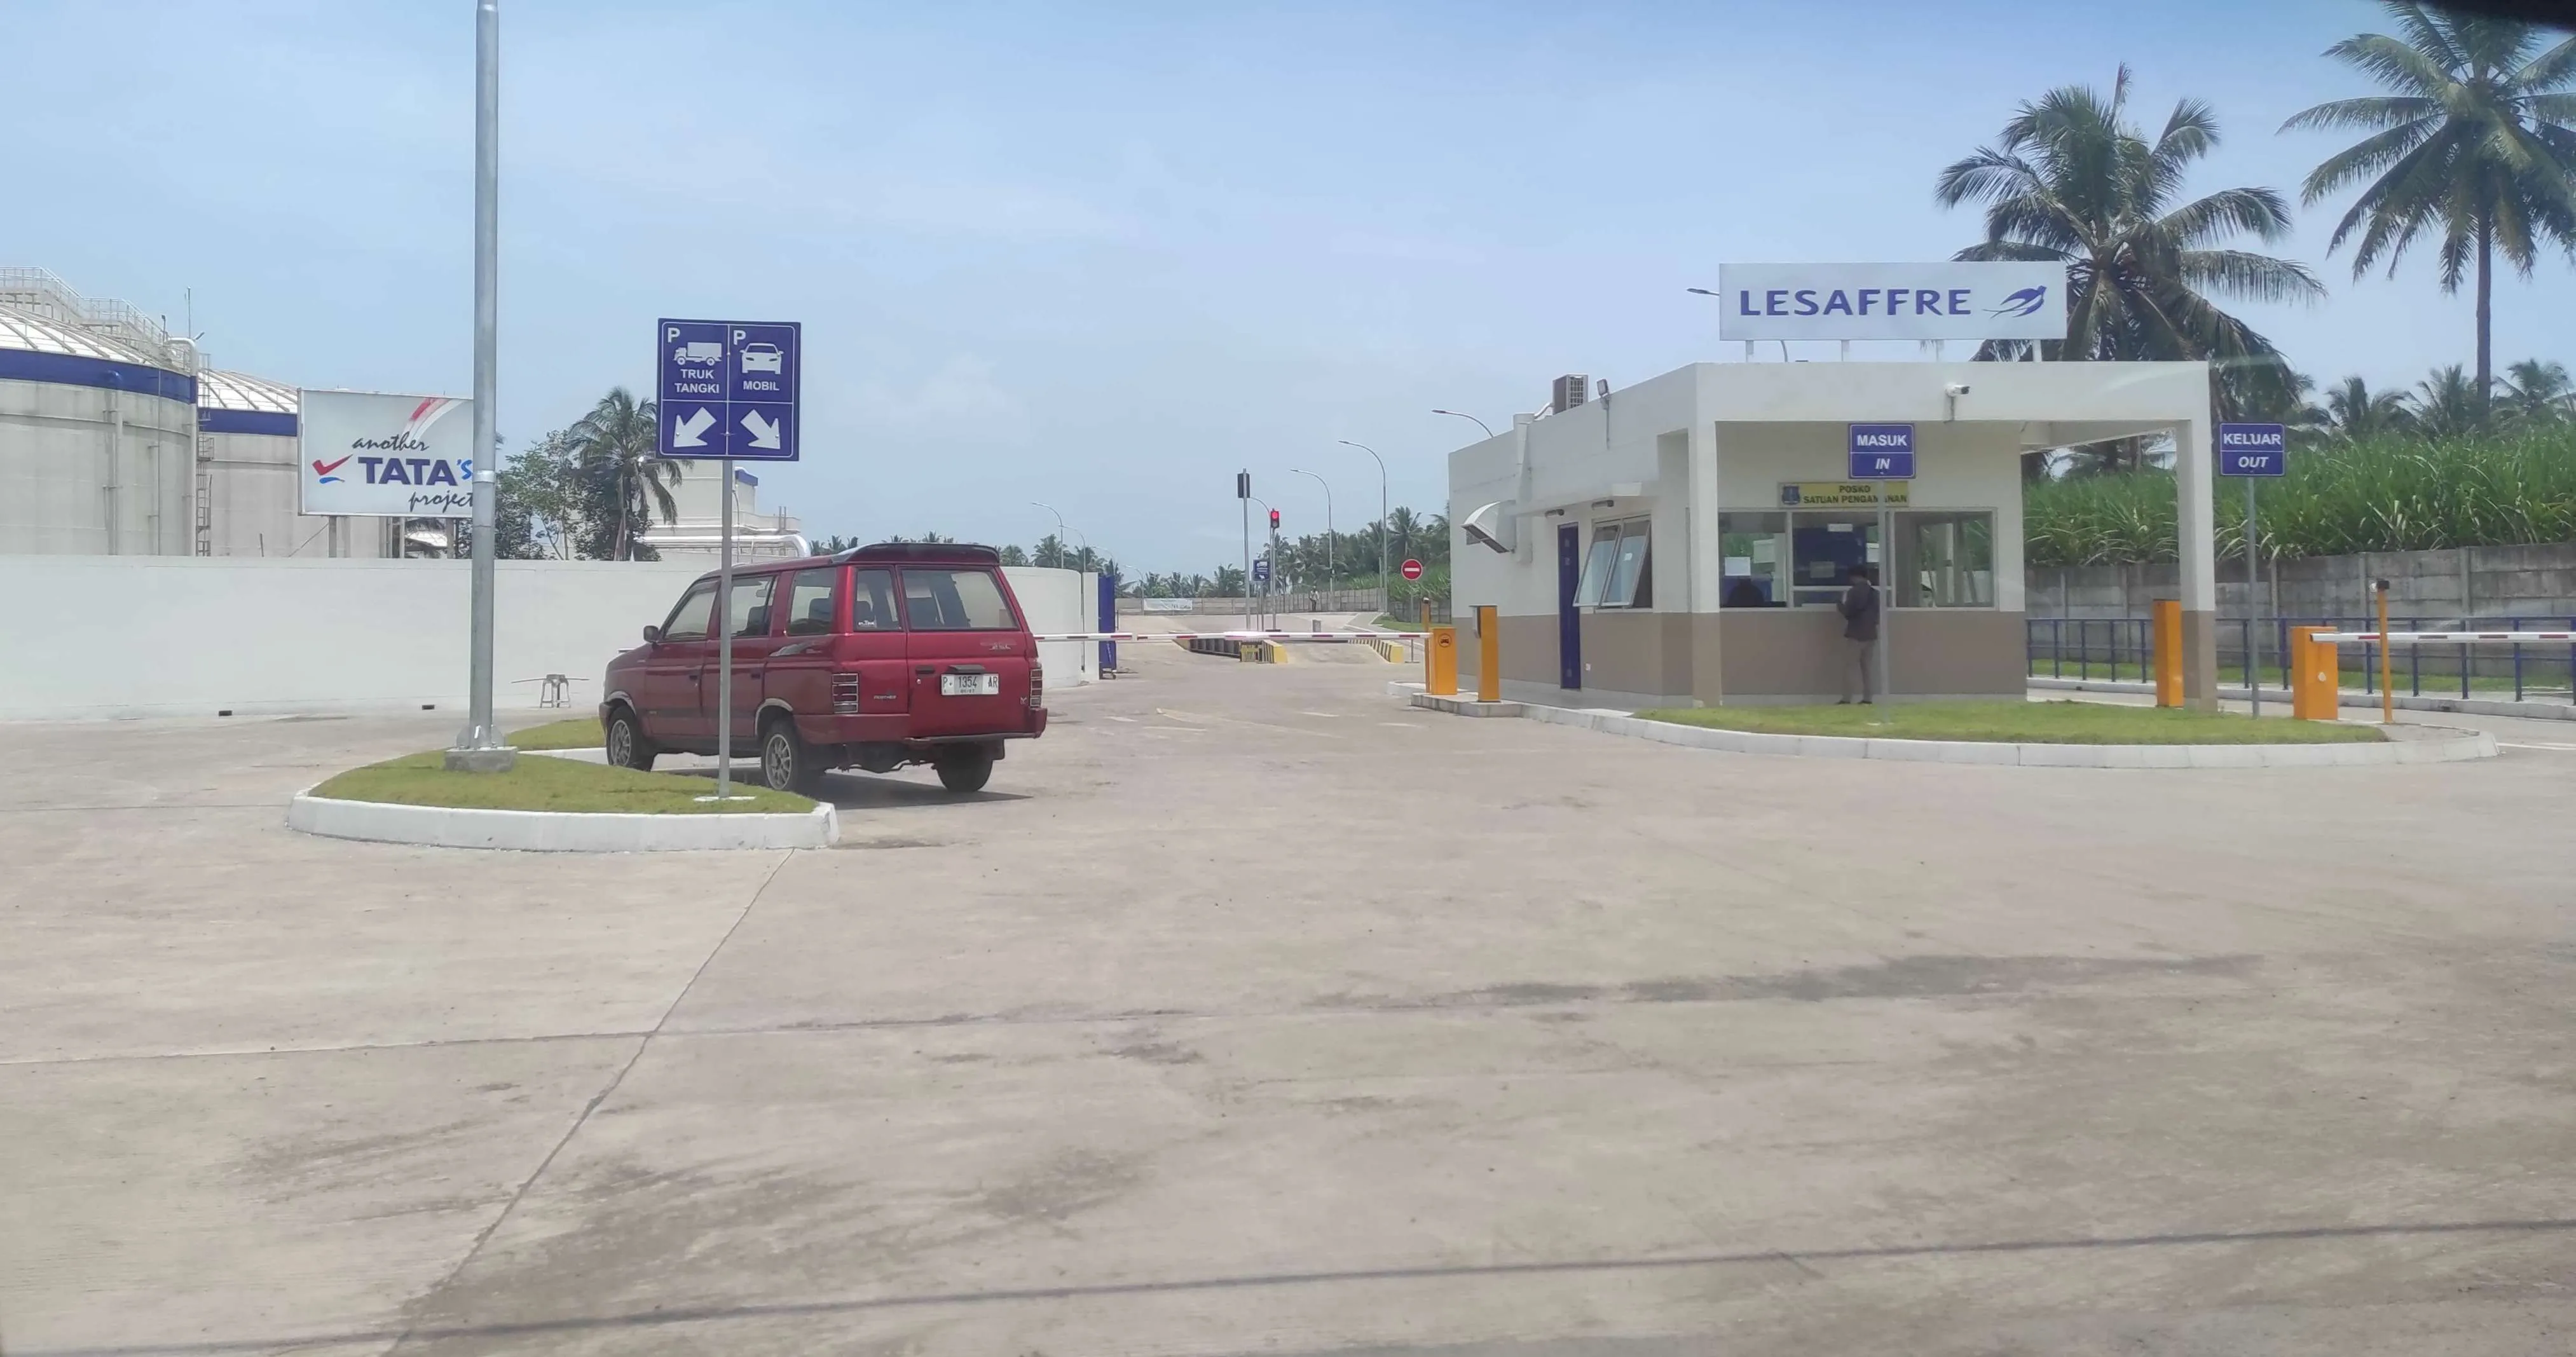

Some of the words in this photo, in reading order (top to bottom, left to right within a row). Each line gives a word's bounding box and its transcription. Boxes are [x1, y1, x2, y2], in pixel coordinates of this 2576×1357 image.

[1740, 289, 1971, 316] LESAFFRE
[668, 327, 680, 343] P
[733, 330, 746, 345] P
[680, 369, 714, 379] TRUK
[674, 383, 720, 393] TANGKI
[743, 381, 779, 391] MOBIL
[352, 431, 430, 451] another
[1857, 434, 1907, 446] MASUK
[2223, 433, 2281, 445] KELUAR
[1875, 458, 1890, 469] IN
[2238, 456, 2269, 468] OUT
[1839, 485, 1870, 493] POSKO
[408, 490, 473, 513] project
[1804, 496, 1839, 504] SATUAN
[943, 676, 948, 688] P
[958, 676, 977, 688] 1354
[987, 676, 997, 688] AR
